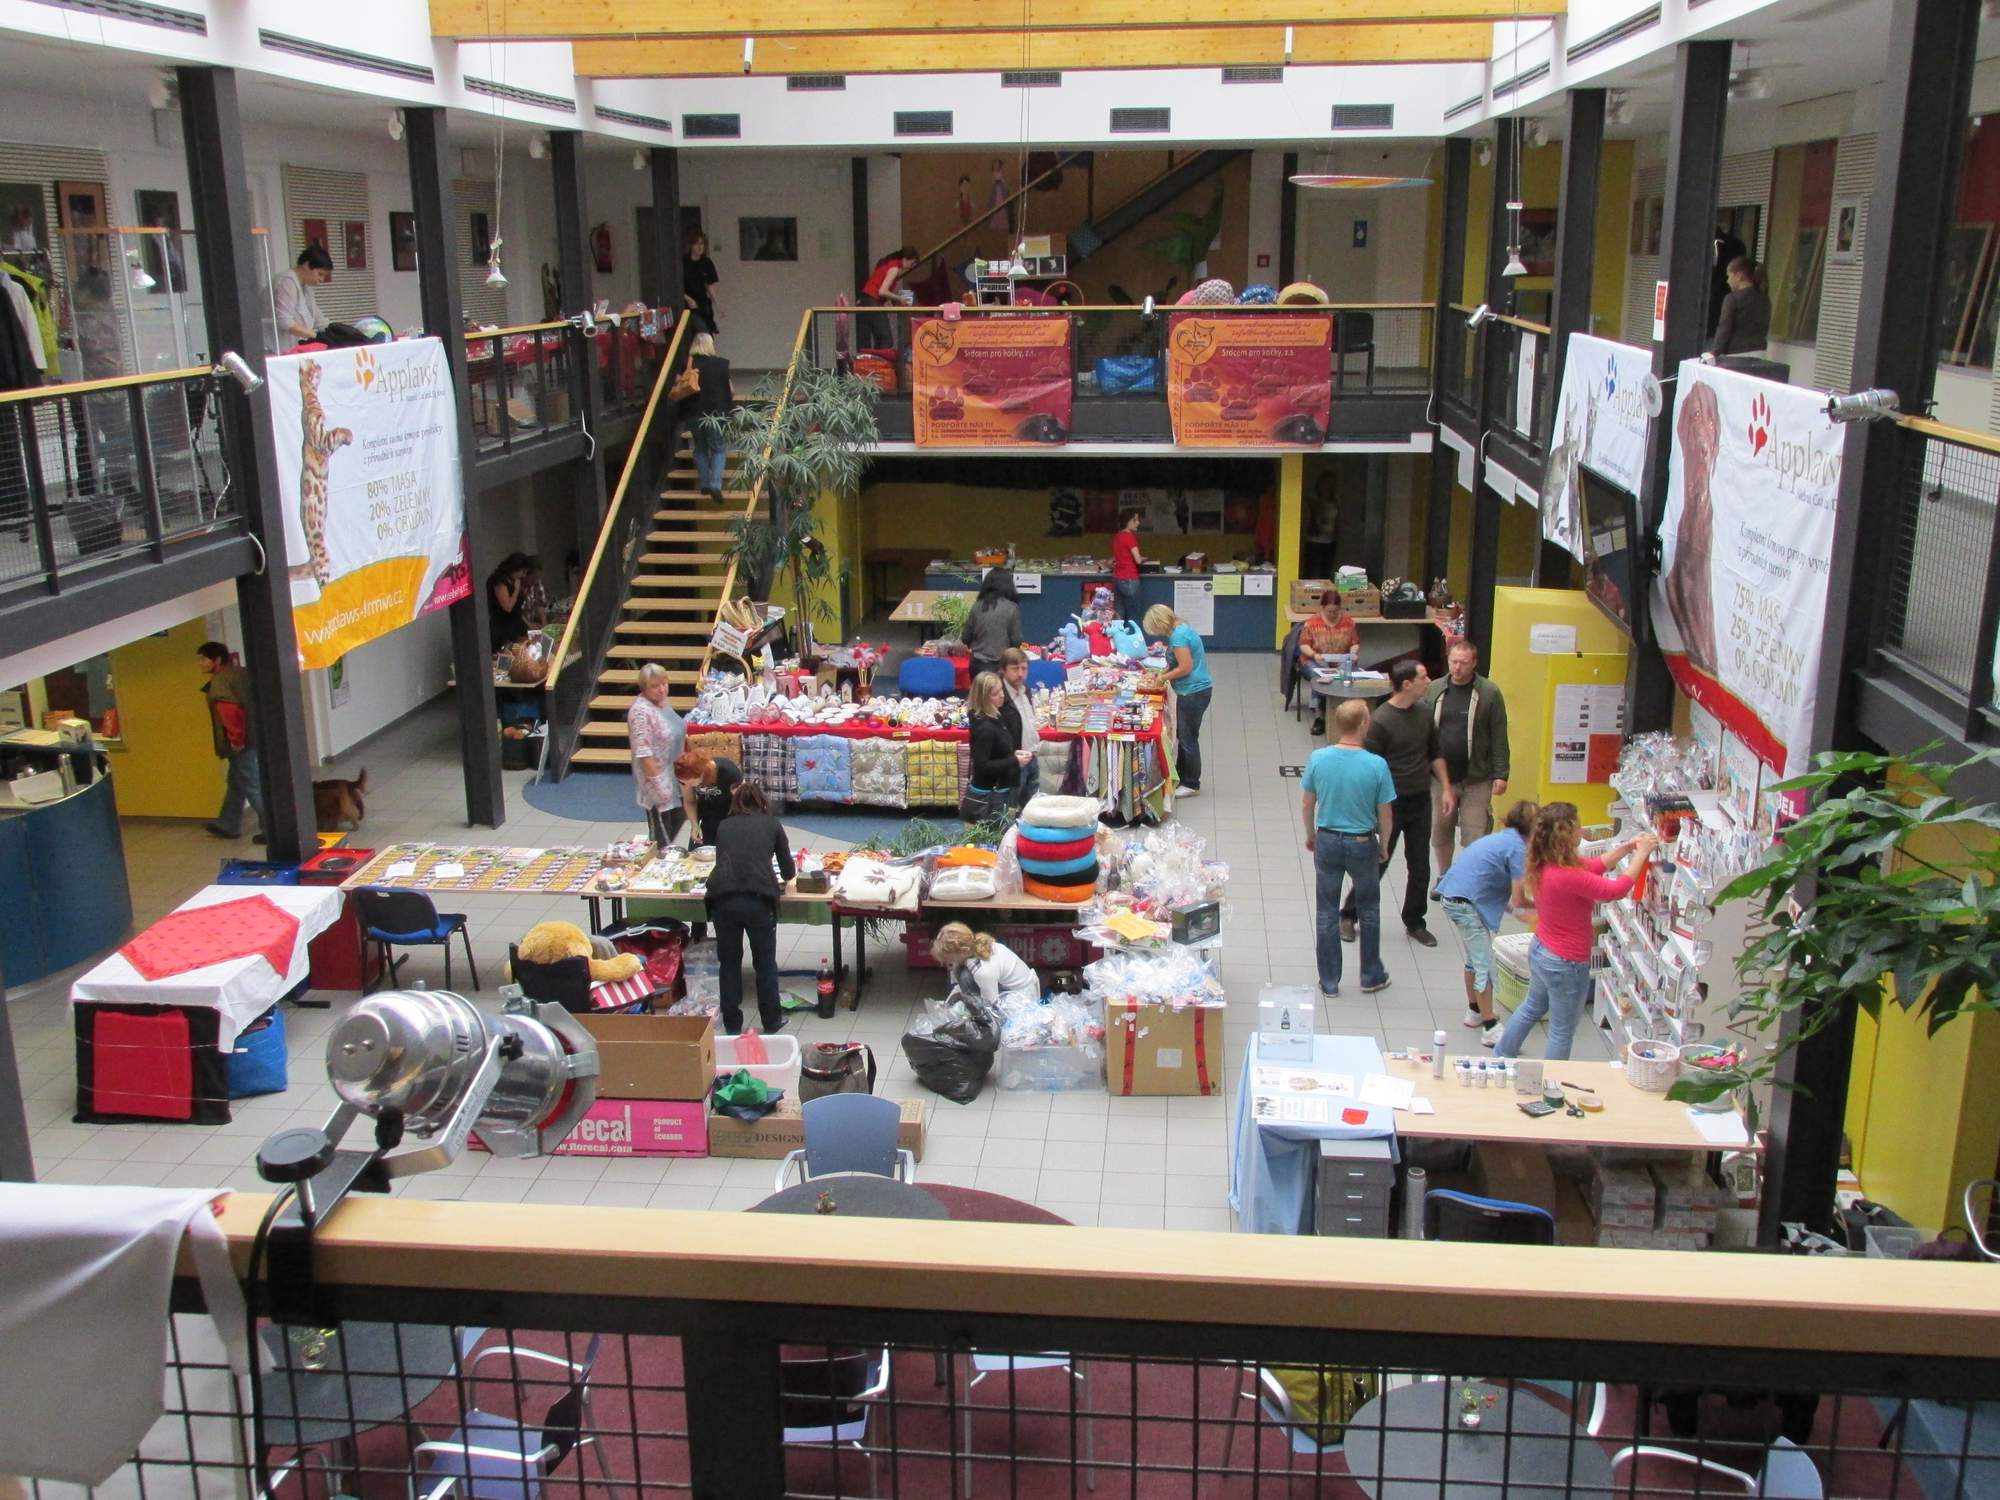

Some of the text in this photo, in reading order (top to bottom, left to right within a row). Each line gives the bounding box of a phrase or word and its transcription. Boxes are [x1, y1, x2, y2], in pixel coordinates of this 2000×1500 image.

[376, 358, 438, 403] Applaws
[1613, 376, 1648, 428] Appla
[367, 479, 389, 499] 80%
[369, 500, 391, 521] 20%
[377, 522, 394, 541] 0%
[1733, 582, 1754, 616] 75%
[1730, 612, 1752, 648] 25%
[1735, 647, 1751, 679] 0%
[653, 1118, 682, 1126] PRODUCT
[654, 1133, 683, 1141] ECUADOR
